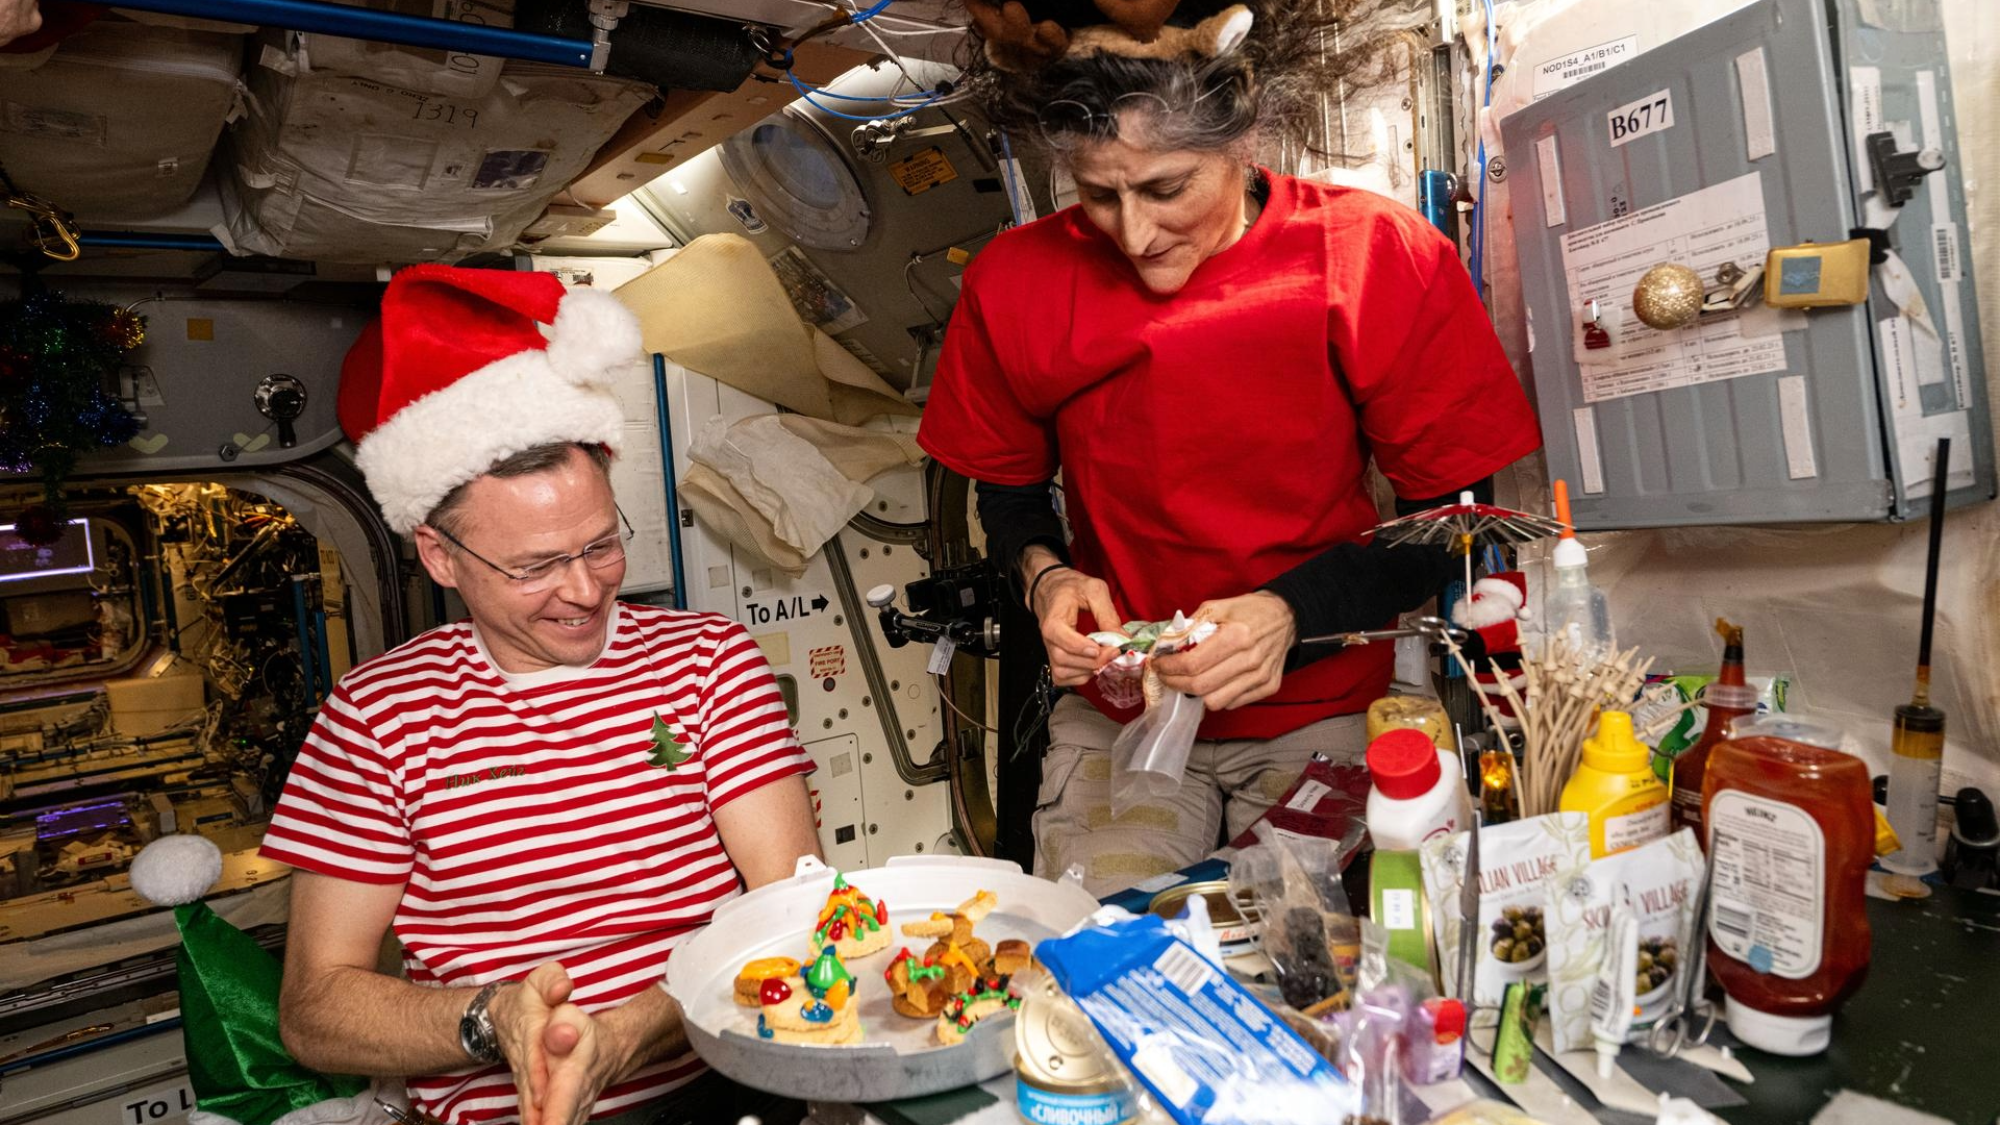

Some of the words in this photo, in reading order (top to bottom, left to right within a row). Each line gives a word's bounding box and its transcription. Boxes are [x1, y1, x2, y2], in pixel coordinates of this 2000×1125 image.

[1542, 42, 1627, 75] NOD1S4_A1/B1/C1
[411, 101, 480, 130] 1319
[1610, 97, 1669, 143] B677
[746, 602, 771, 625] To
[775, 595, 811, 621] A/L
[1743, 805, 1778, 823] HEINZ
[126, 1098, 168, 1125] To
